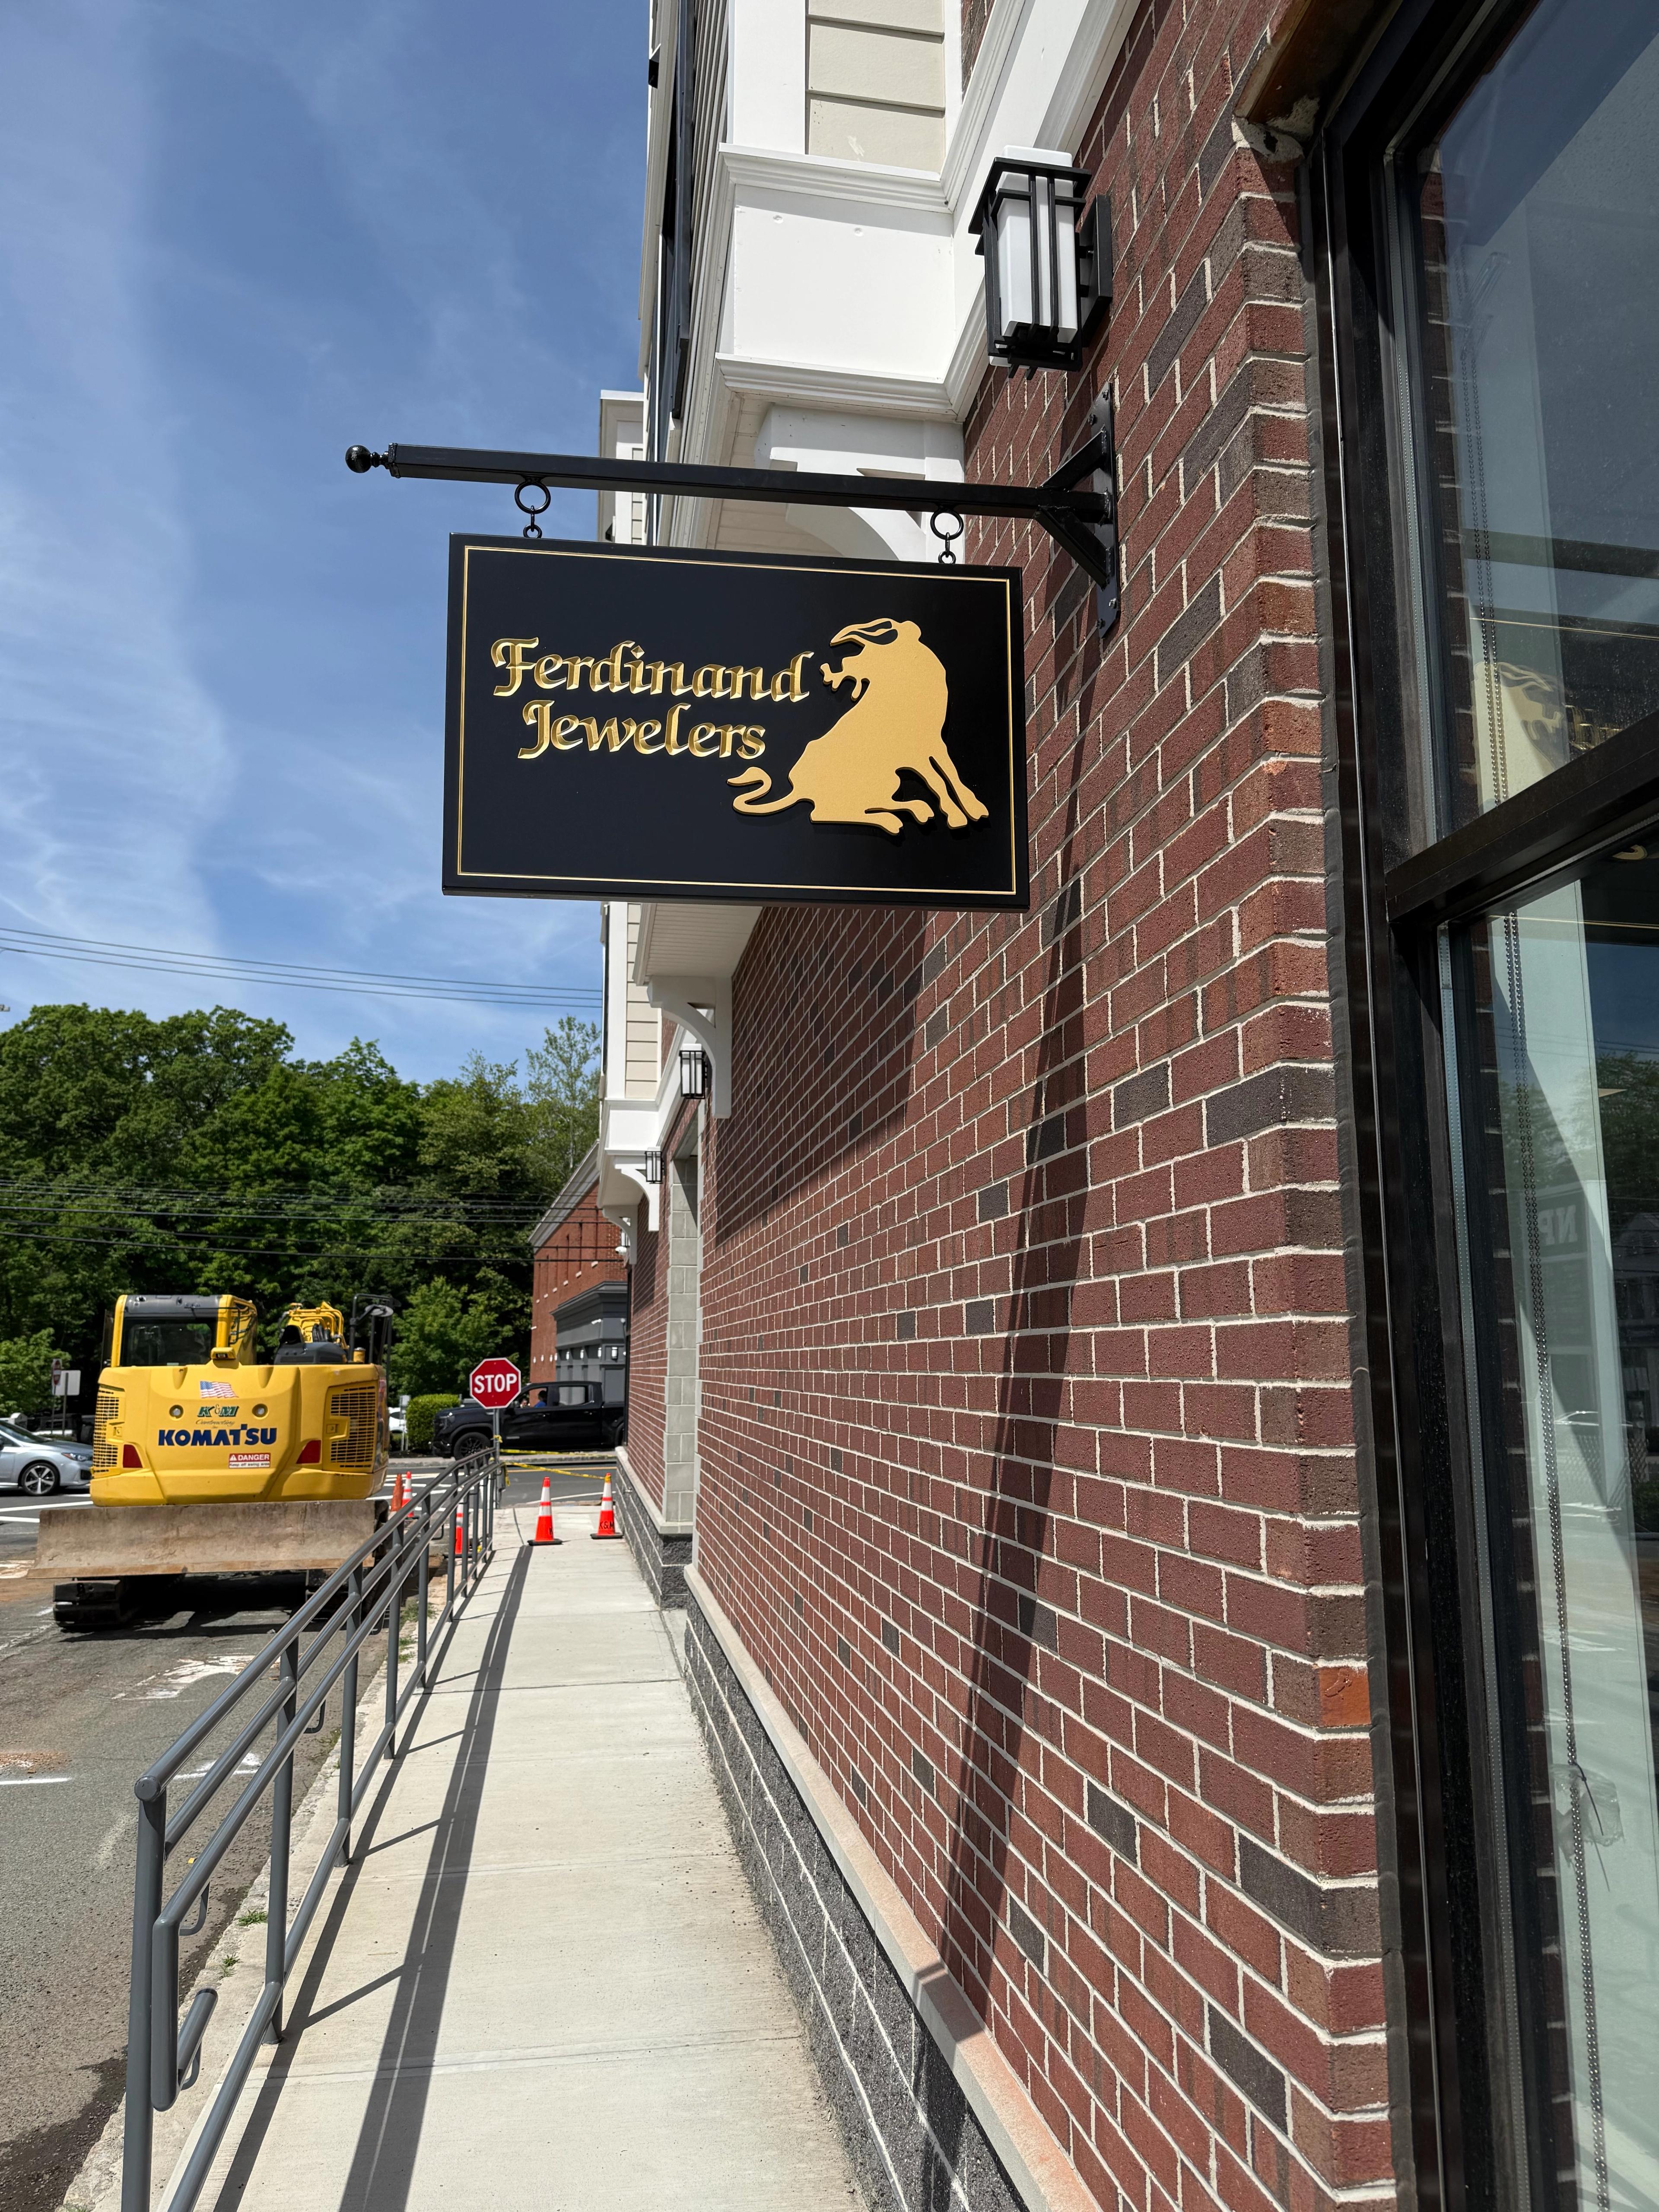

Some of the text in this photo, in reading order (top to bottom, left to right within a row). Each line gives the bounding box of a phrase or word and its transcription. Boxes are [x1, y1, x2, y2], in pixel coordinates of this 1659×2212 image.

[491, 637, 814, 703] Ferdinand
[518, 699, 766, 760] Jewelers
[474, 1373, 517, 1394] STOP
[158, 1424, 277, 1446] KOMATSU
